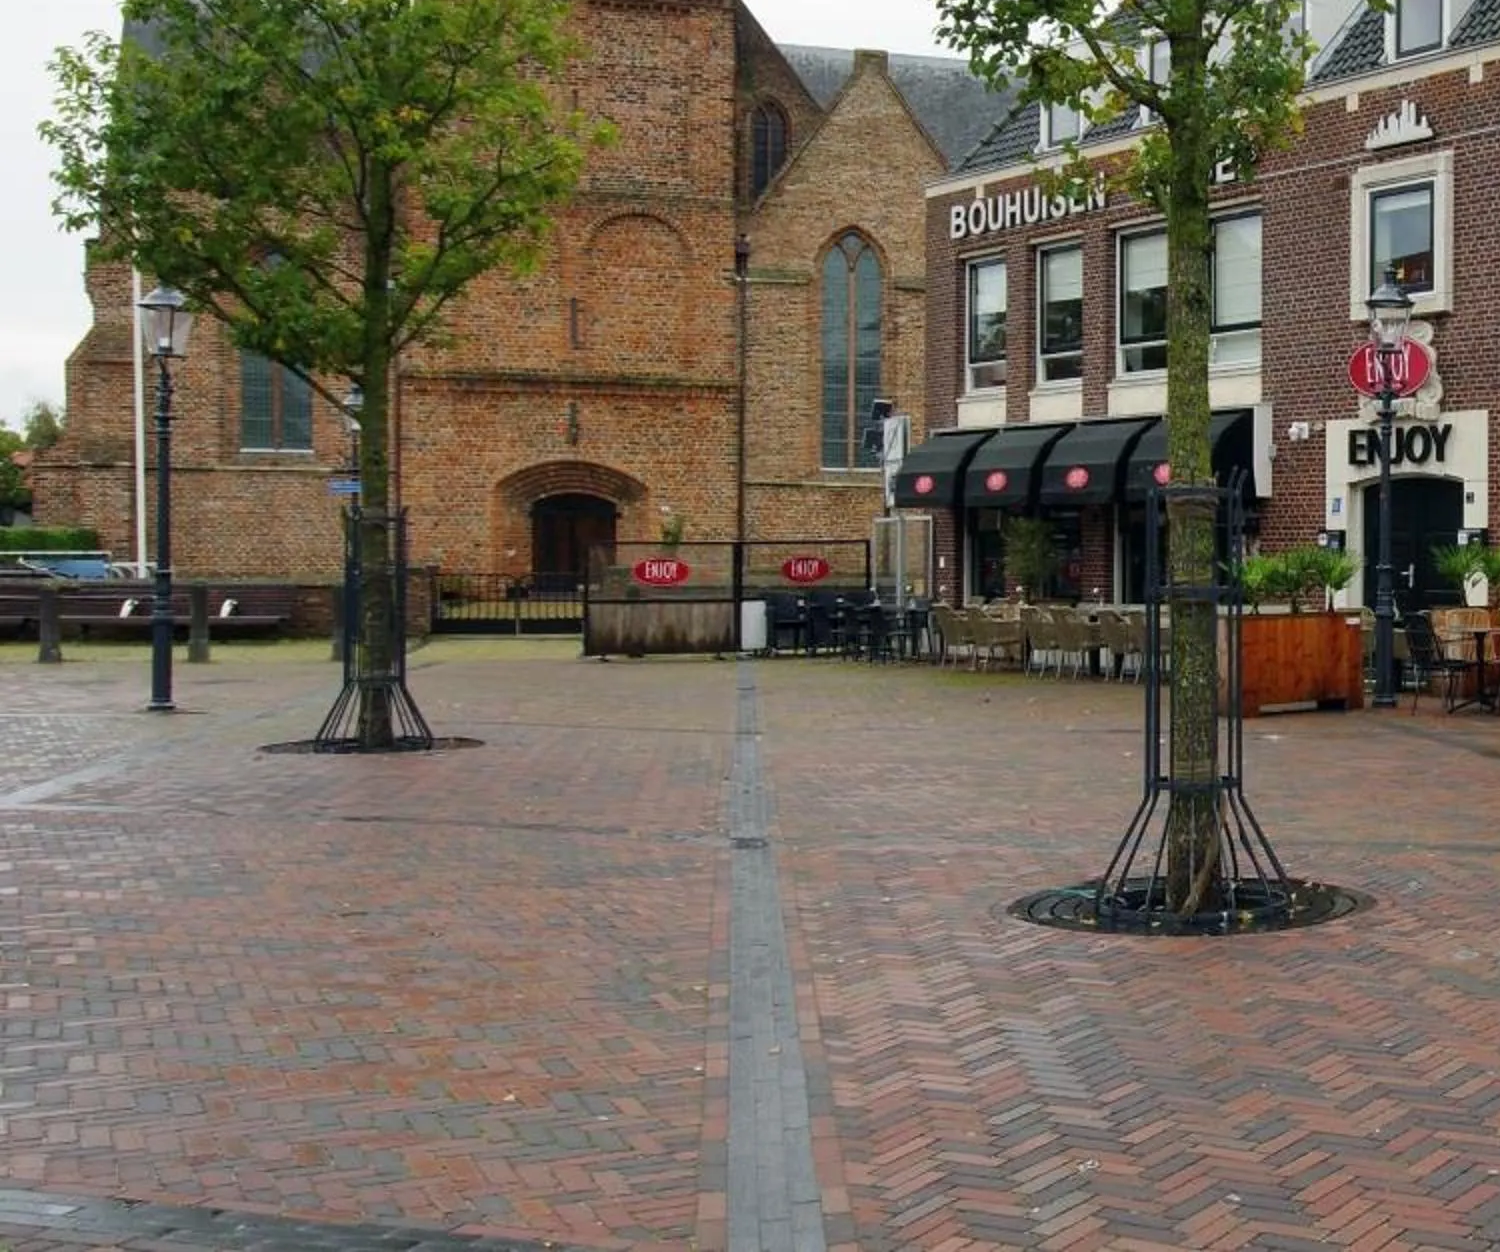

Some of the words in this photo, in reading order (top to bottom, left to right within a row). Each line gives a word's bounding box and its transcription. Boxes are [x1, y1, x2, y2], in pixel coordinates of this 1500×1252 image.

[1365, 344, 1410, 383] ENOY
[1348, 424, 1453, 465] ENJOY
[645, 561, 677, 579] ENJOY
[791, 560, 819, 577] ENJOY
